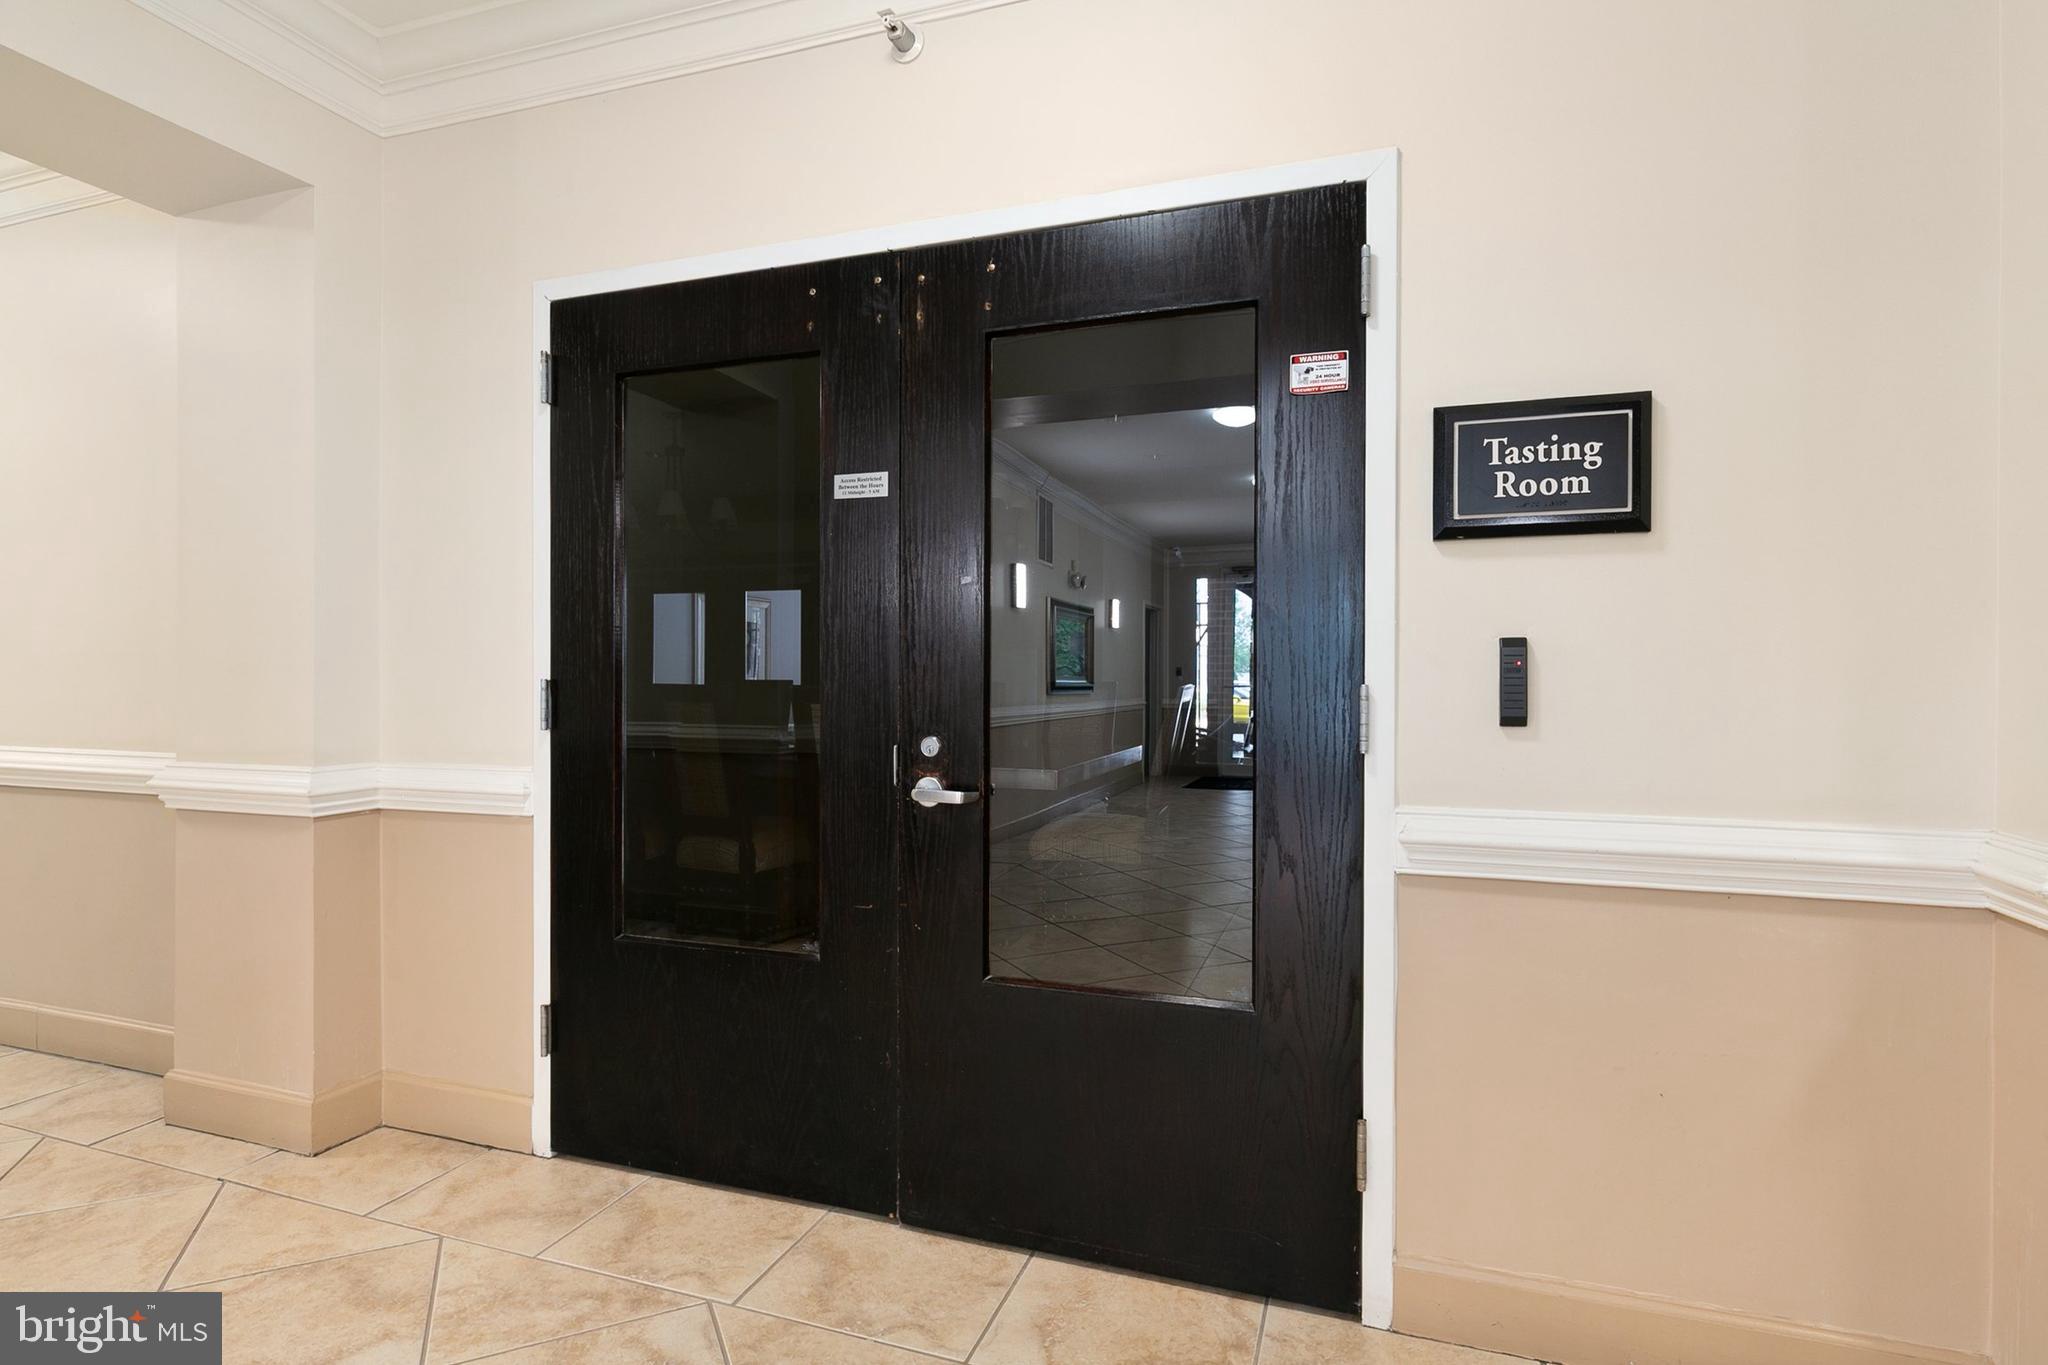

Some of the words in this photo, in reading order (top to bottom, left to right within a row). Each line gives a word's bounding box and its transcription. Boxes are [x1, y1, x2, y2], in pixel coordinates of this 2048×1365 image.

[1299, 354, 1339, 362] WARNING
[1483, 434, 1603, 470] Tasting
[1494, 471, 1590, 498] Room
